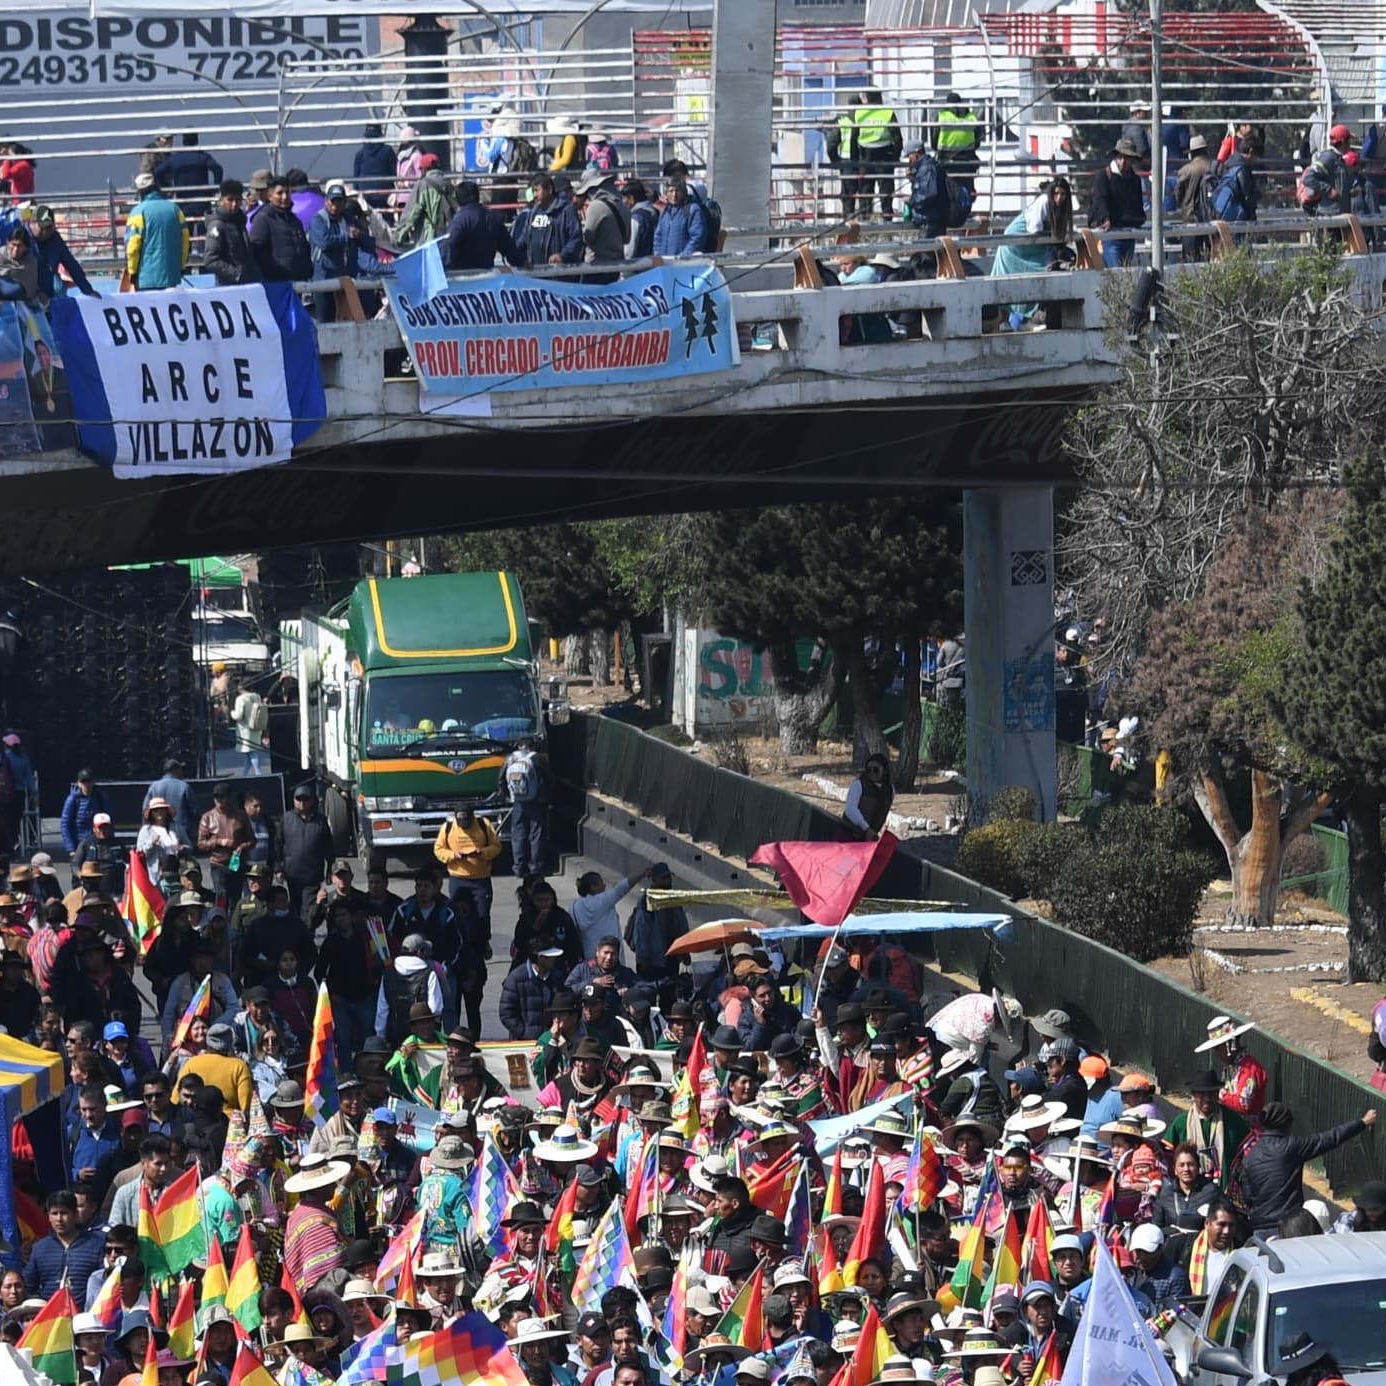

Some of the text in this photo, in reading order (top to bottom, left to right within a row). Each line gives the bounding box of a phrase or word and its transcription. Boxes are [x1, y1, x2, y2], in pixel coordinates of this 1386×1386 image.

[103, 300, 262, 346] BRIGADA
[397, 294, 437, 328] SUB
[435, 290, 503, 327] CENTRAL
[414, 338, 463, 378] PROV.
[464, 335, 540, 377] CERCADO
[551, 328, 671, 374] COCHABAMBA
[141, 357, 254, 404] ARCE
[128, 416, 274, 466] VILLAZON
[372, 733, 400, 745] SANTA
